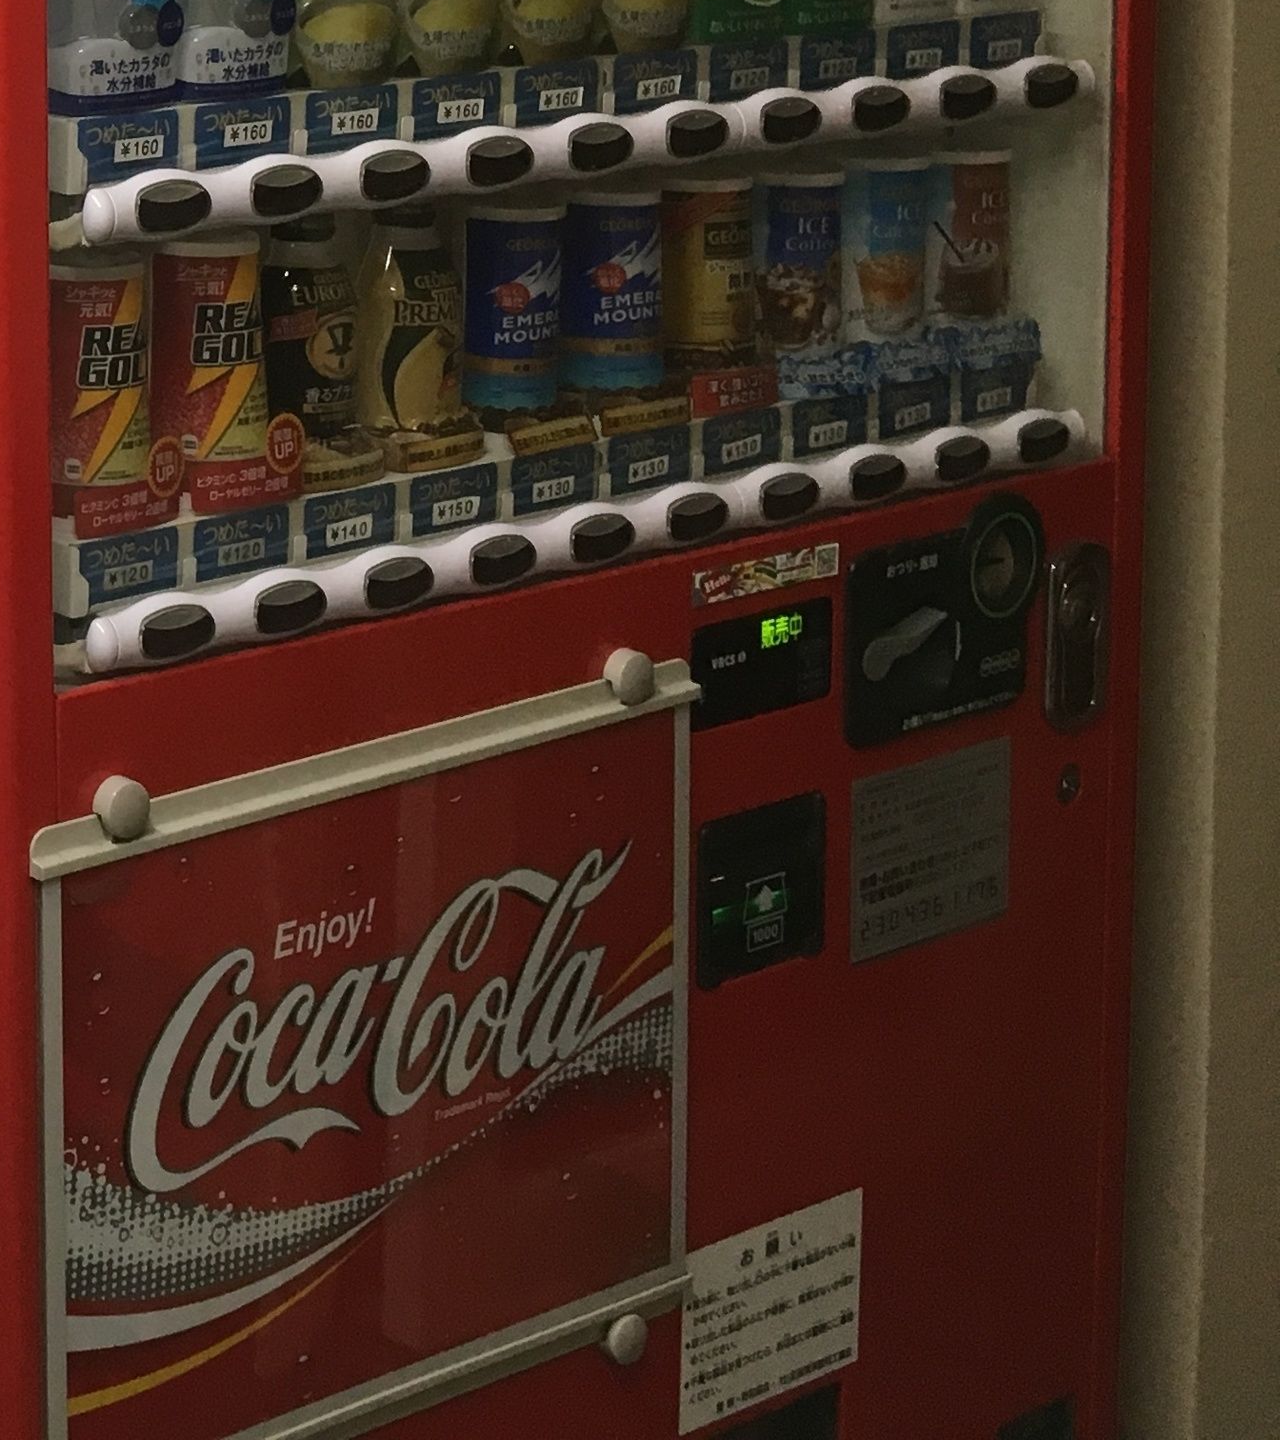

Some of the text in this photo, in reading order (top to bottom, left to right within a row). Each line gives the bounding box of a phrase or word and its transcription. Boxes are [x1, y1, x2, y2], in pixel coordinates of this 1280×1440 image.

[444, 103, 480, 118] ¥160
[338, 114, 374, 130] ¥160
[231, 125, 267, 140] ¥160
[121, 140, 159, 156] ¥160
[437, 500, 473, 518] ¥150
[329, 521, 368, 541] ¥140
[761, 612, 802, 649] 販売中
[275, 899, 377, 960] Enjoy!
[752, 923, 778, 943] 1000
[124, 838, 632, 1195] Coca-Cola
